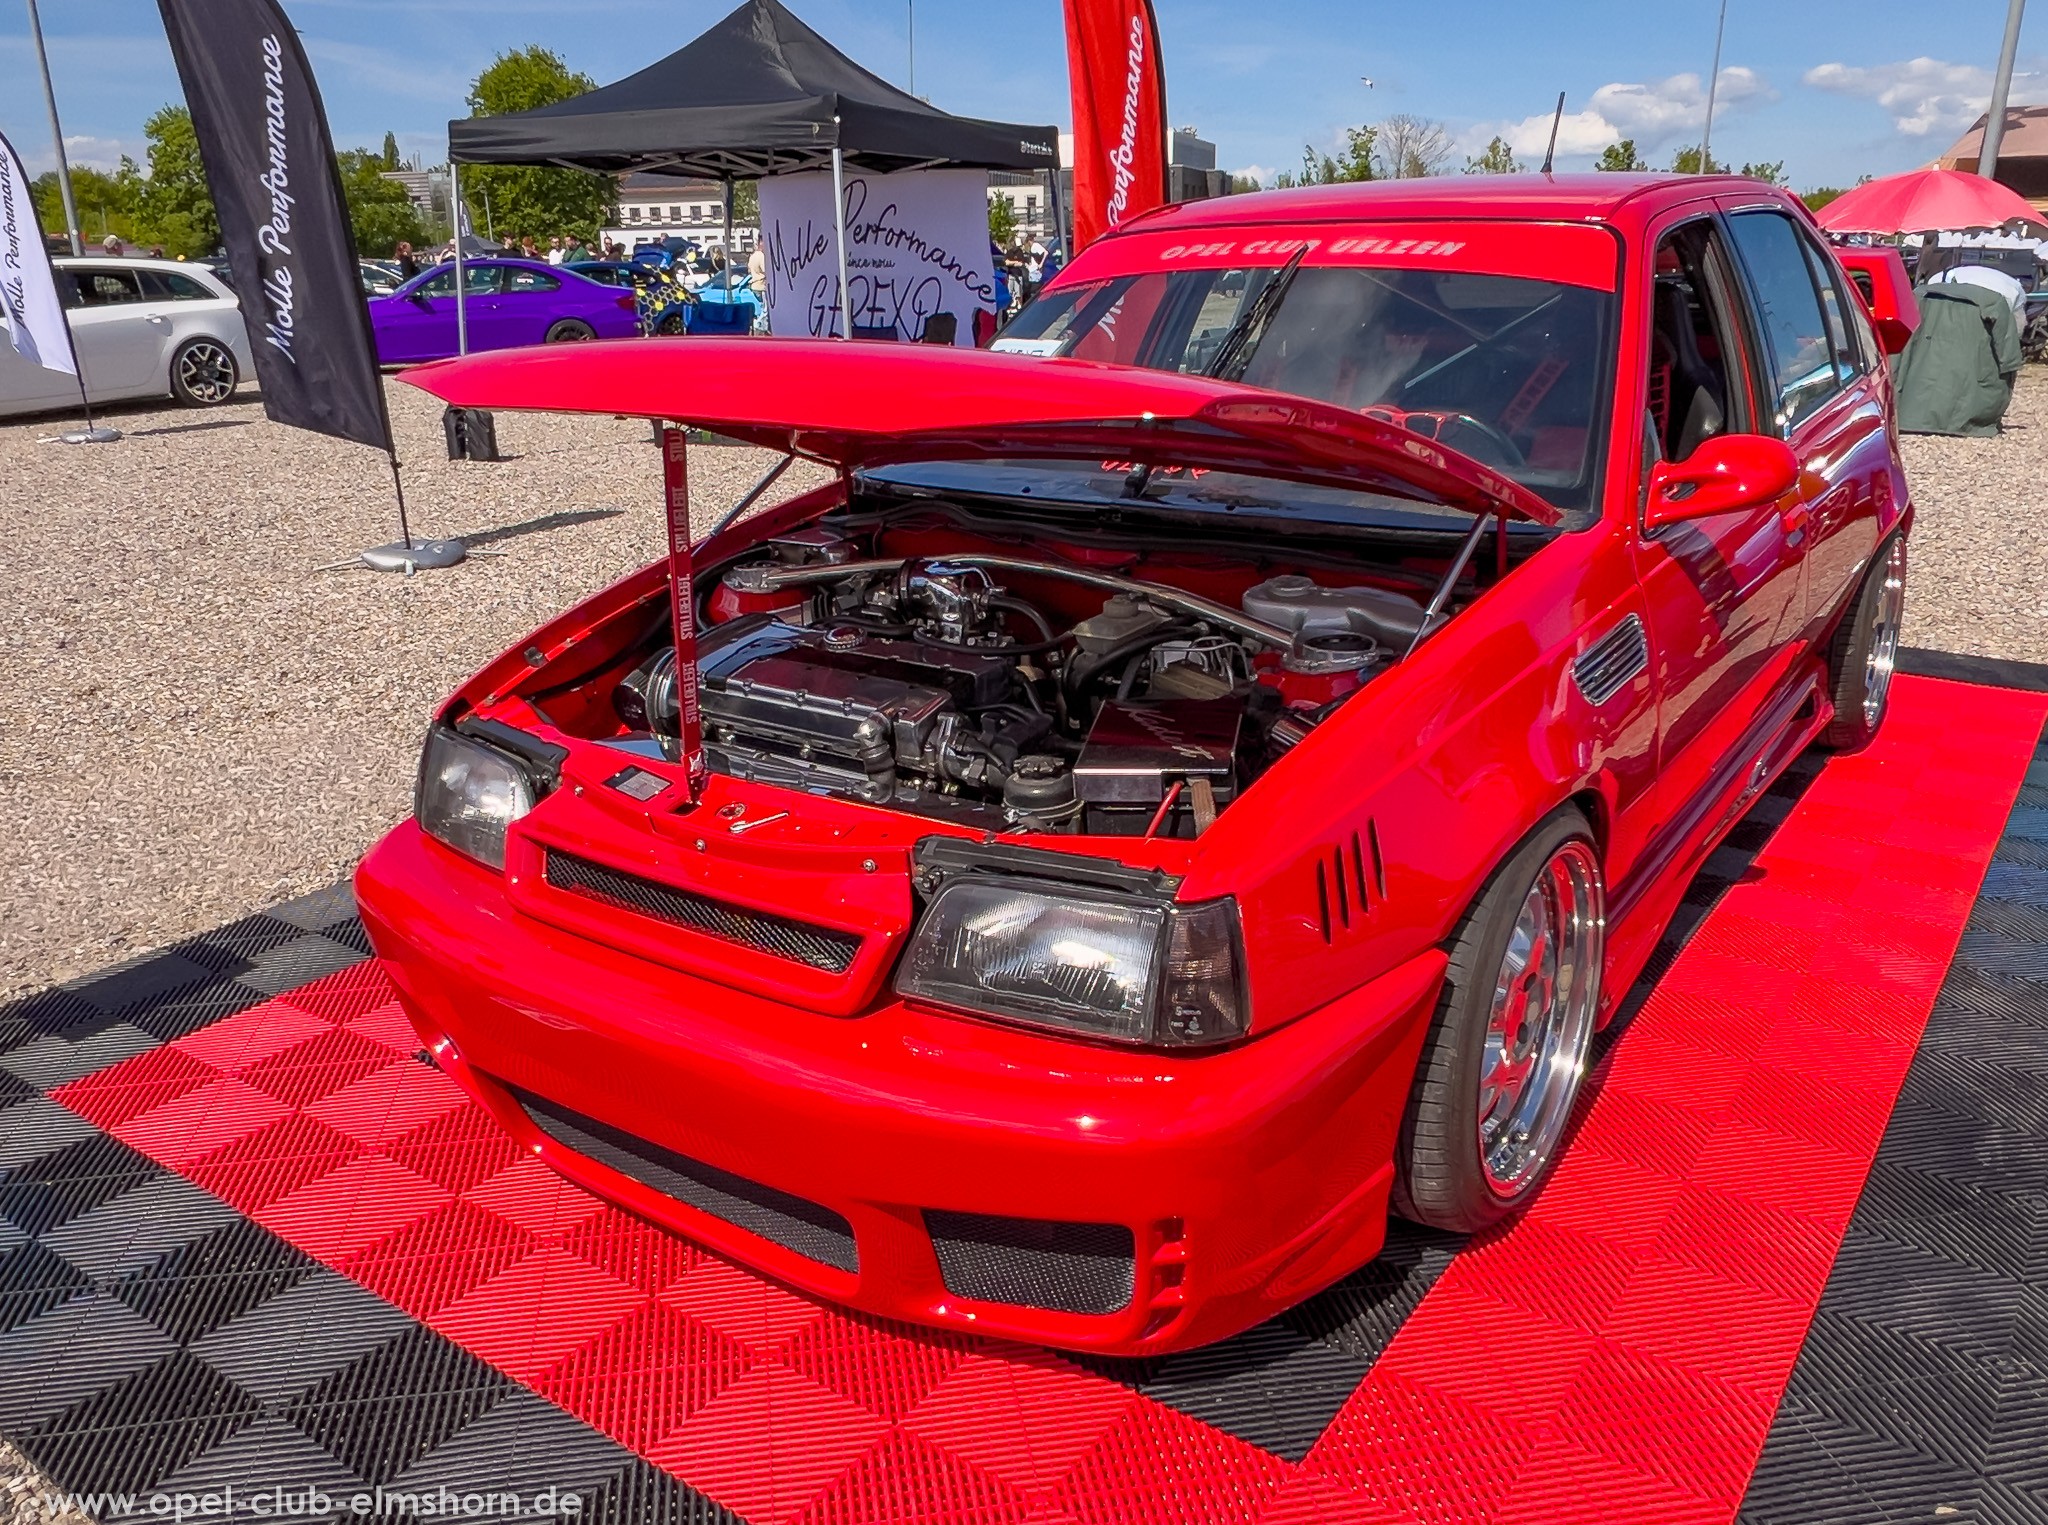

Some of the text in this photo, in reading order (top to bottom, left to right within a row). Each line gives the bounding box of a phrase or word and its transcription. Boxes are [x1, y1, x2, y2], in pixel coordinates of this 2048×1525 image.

[258, 33, 296, 364] Molle Performance
[766, 179, 997, 309] Molle Performance
[846, 251, 871, 269] ince
[1161, 242, 1238, 260] OPEL
[1327, 239, 1467, 256] UELZEN
[6, 275, 27, 330] Molle
